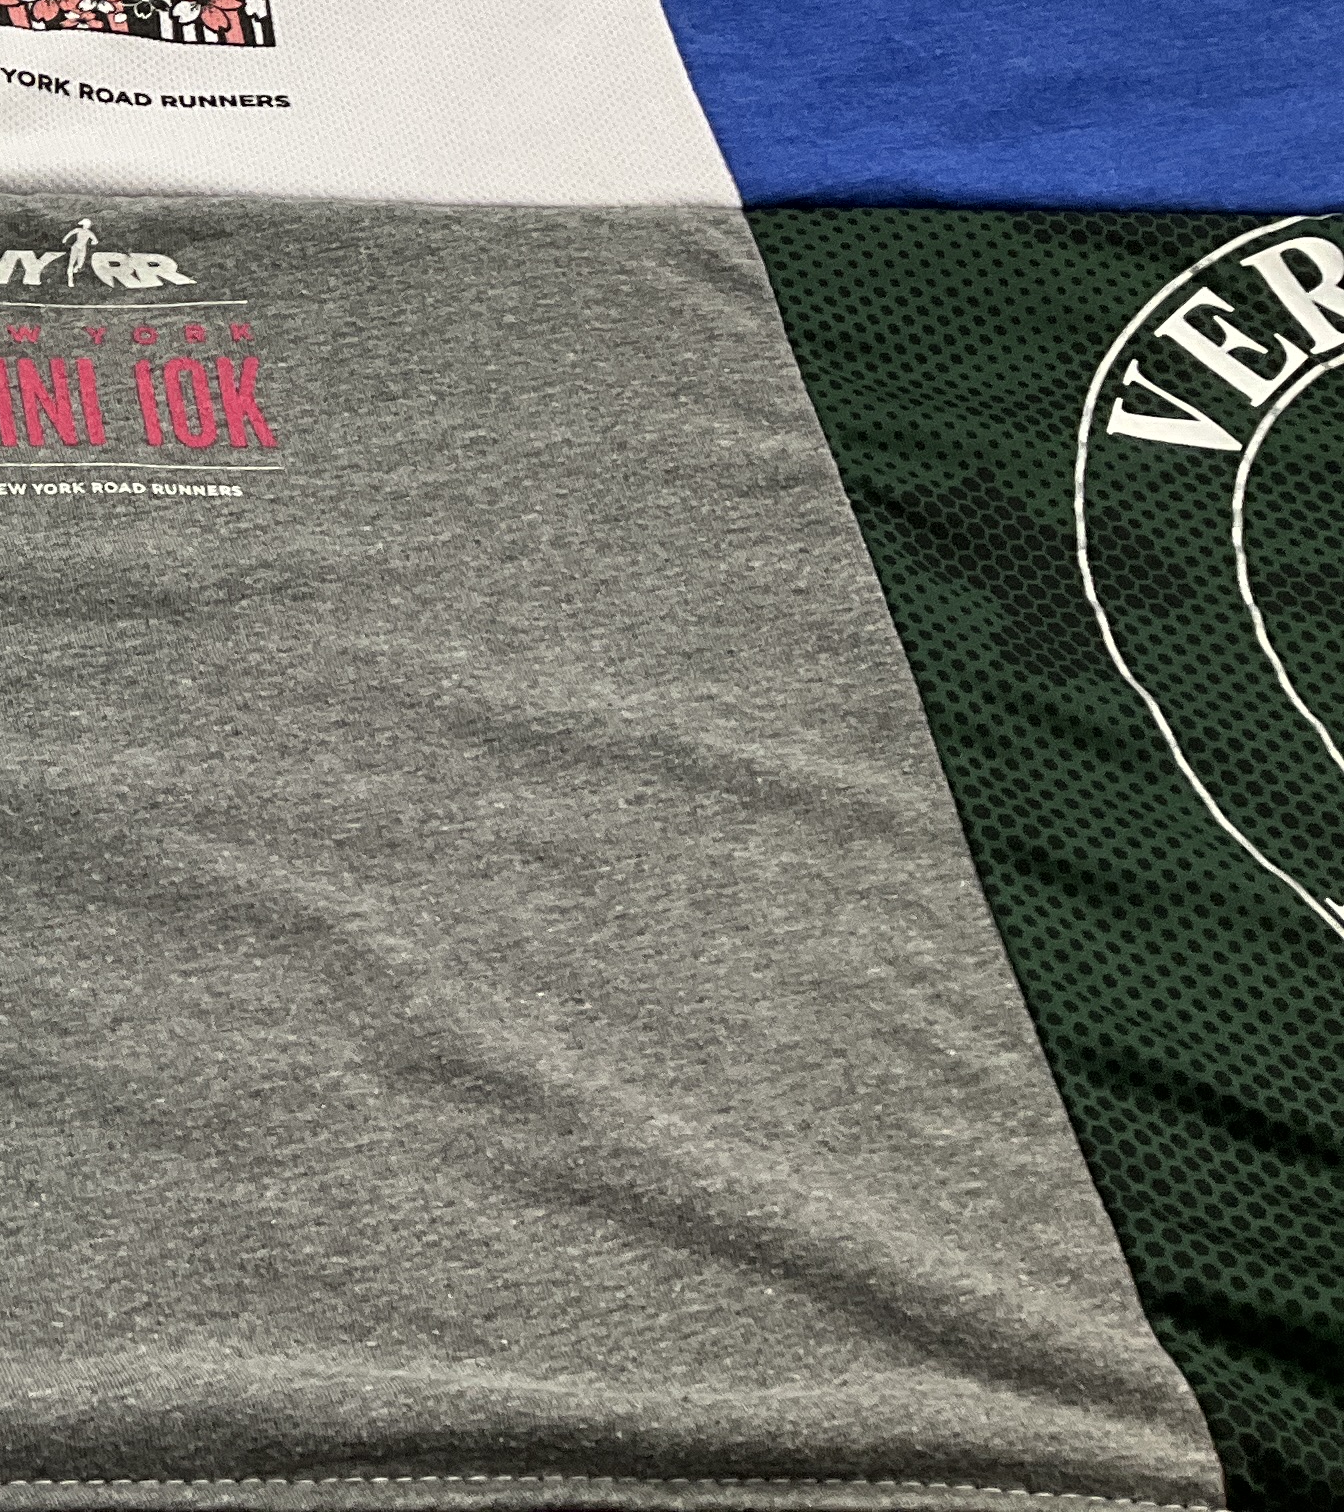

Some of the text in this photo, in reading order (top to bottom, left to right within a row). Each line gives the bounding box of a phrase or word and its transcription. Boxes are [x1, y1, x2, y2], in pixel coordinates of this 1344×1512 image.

[0, 67, 70, 96] YORK
[79, 82, 152, 107] ROAD
[160, 93, 291, 108] RUNNERS
[84, 322, 254, 345] YORK
[32, 483, 86, 496] YORK
[91, 482, 146, 495] ROAD
[151, 486, 243, 498] RUNNERS
